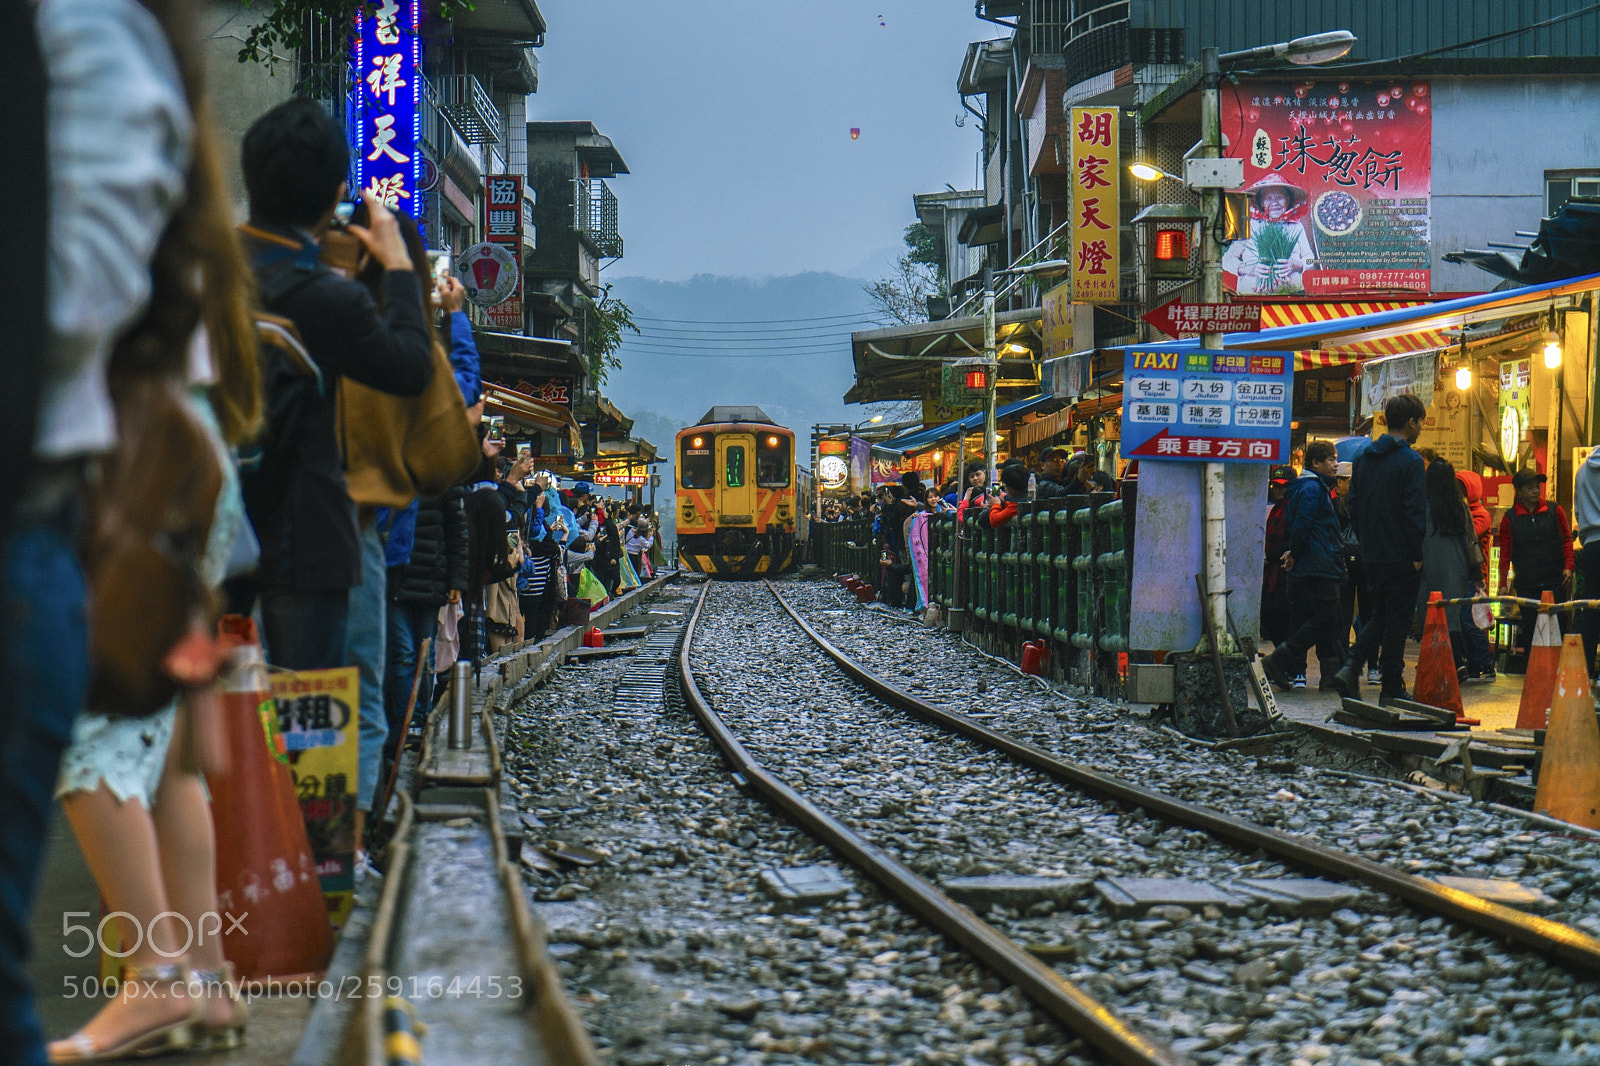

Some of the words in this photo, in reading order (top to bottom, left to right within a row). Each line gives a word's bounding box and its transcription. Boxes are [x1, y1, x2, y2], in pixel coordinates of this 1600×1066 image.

[1077, 111, 1113, 275] 胡家天燈
[1360, 272, 1426, 280] 0987-777-401
[1360, 281, 1426, 289] 02-8259-5605
[1168, 305, 1259, 320] 計程車招呼站
[1175, 321, 1203, 331] TAXI
[1207, 320, 1251, 331] Station
[1132, 352, 1180, 371] TAXI
[1216, 356, 1246, 367] 半日遊
[1252, 357, 1282, 368] 一日遊
[1138, 380, 1171, 392] 台北
[1190, 382, 1224, 393] 九份
[1237, 384, 1284, 395] 金瓜石
[1136, 405, 1170, 416] 基隆
[1189, 406, 1223, 418] 瑞芳
[1237, 408, 1281, 420] 十分瀑布
[1157, 437, 1272, 459] 乘車方向
